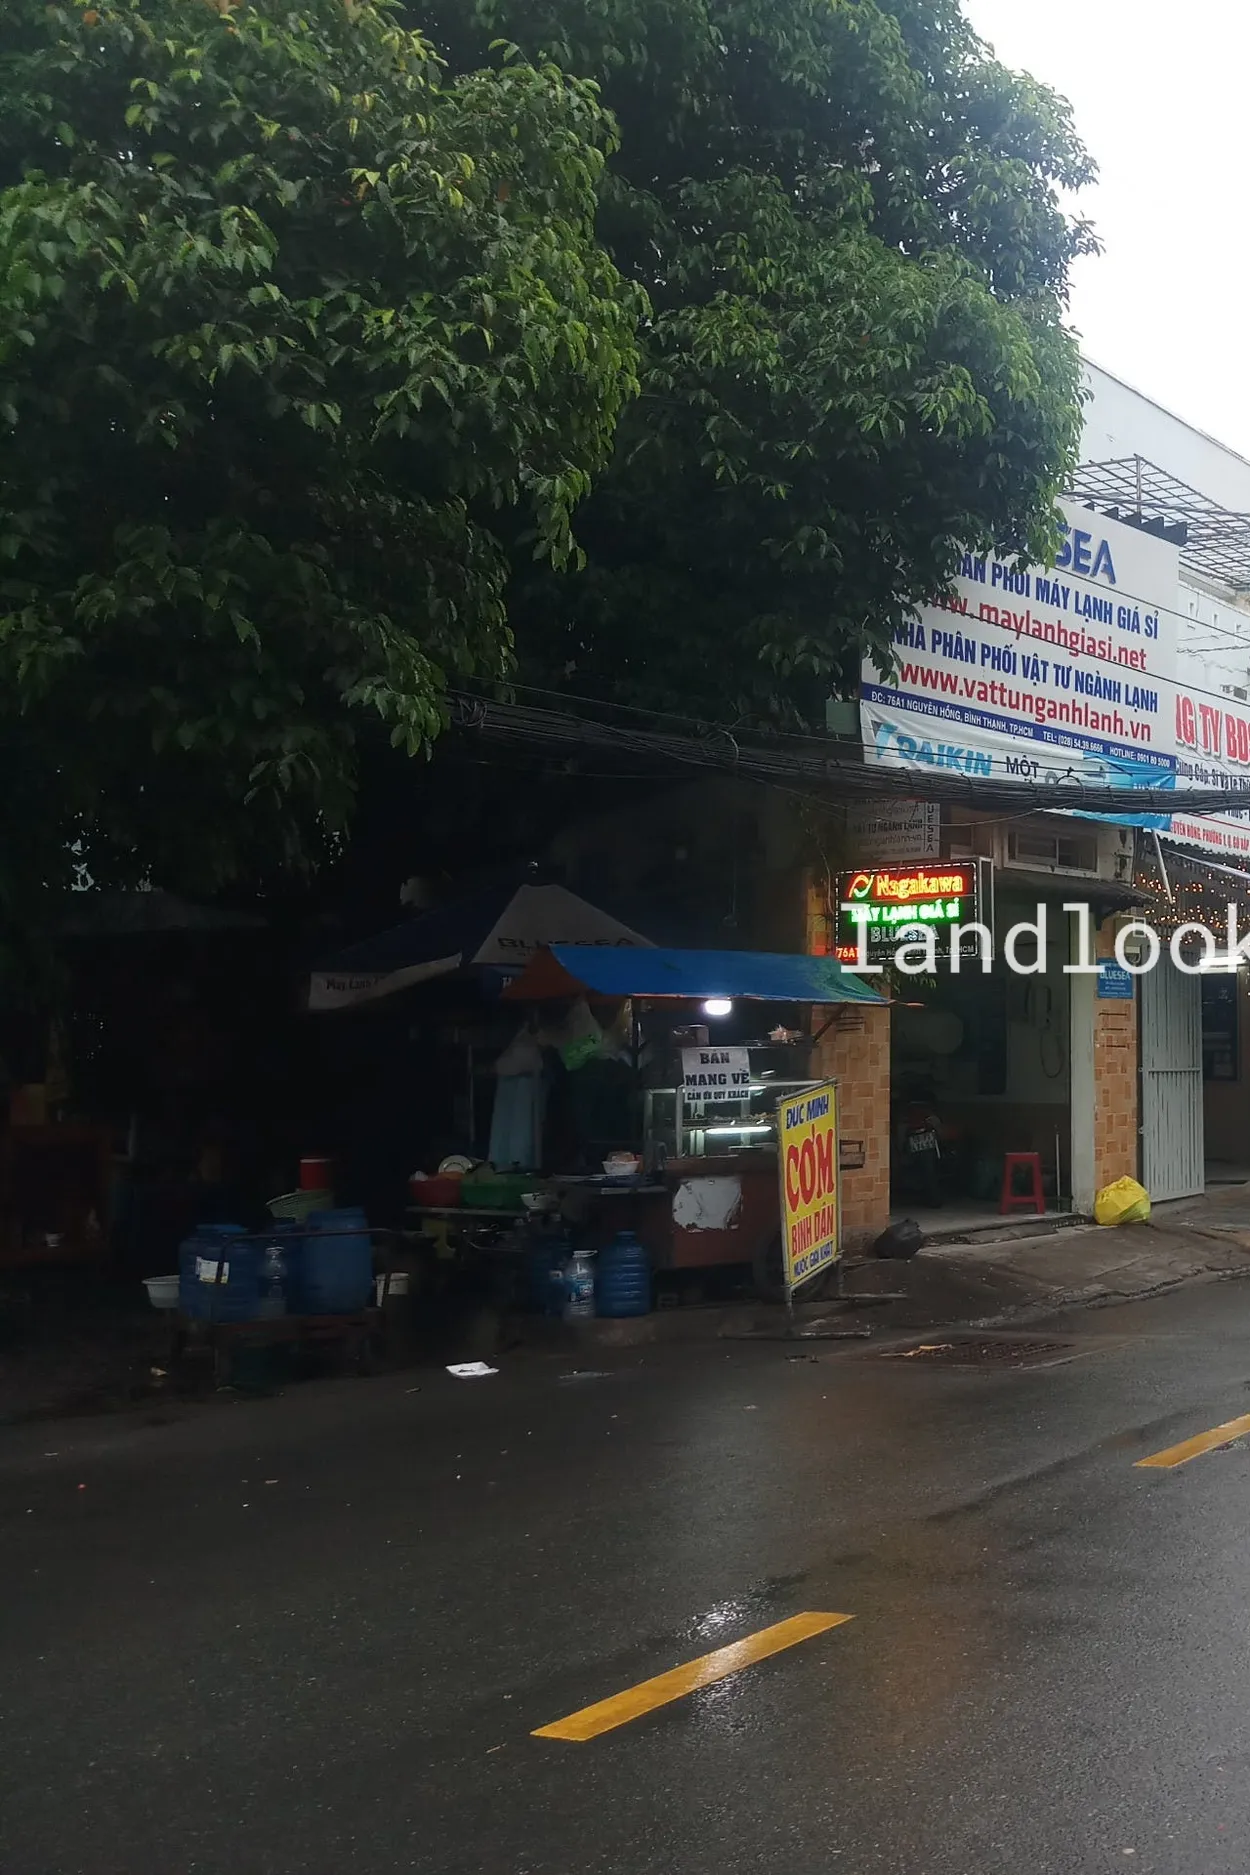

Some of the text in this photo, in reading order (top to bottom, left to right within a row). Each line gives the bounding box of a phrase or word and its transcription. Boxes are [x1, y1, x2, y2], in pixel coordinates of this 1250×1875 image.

[1035, 577, 1071, 610] MÁY
[1074, 590, 1113, 625] LẠNH
[1117, 605, 1141, 634] GIÁ
[931, 630, 976, 665] PHÂN
[980, 643, 1017, 676] PHỐI
[1021, 652, 1049, 687] VẬT
[1053, 663, 1073, 689] TƯ
[1074, 669, 1121, 704] NGÀNH
[1125, 683, 1158, 713] LẠNH
[900, 662, 1151, 742] www.vattunganhlanh.vn
[1199, 702, 1220, 753] TY
[896, 735, 993, 777] DAIKIN
[876, 872, 963, 899] Nagakawa
[684, 1072, 727, 1086] MANG
[786, 1124, 834, 1213] CƠM
